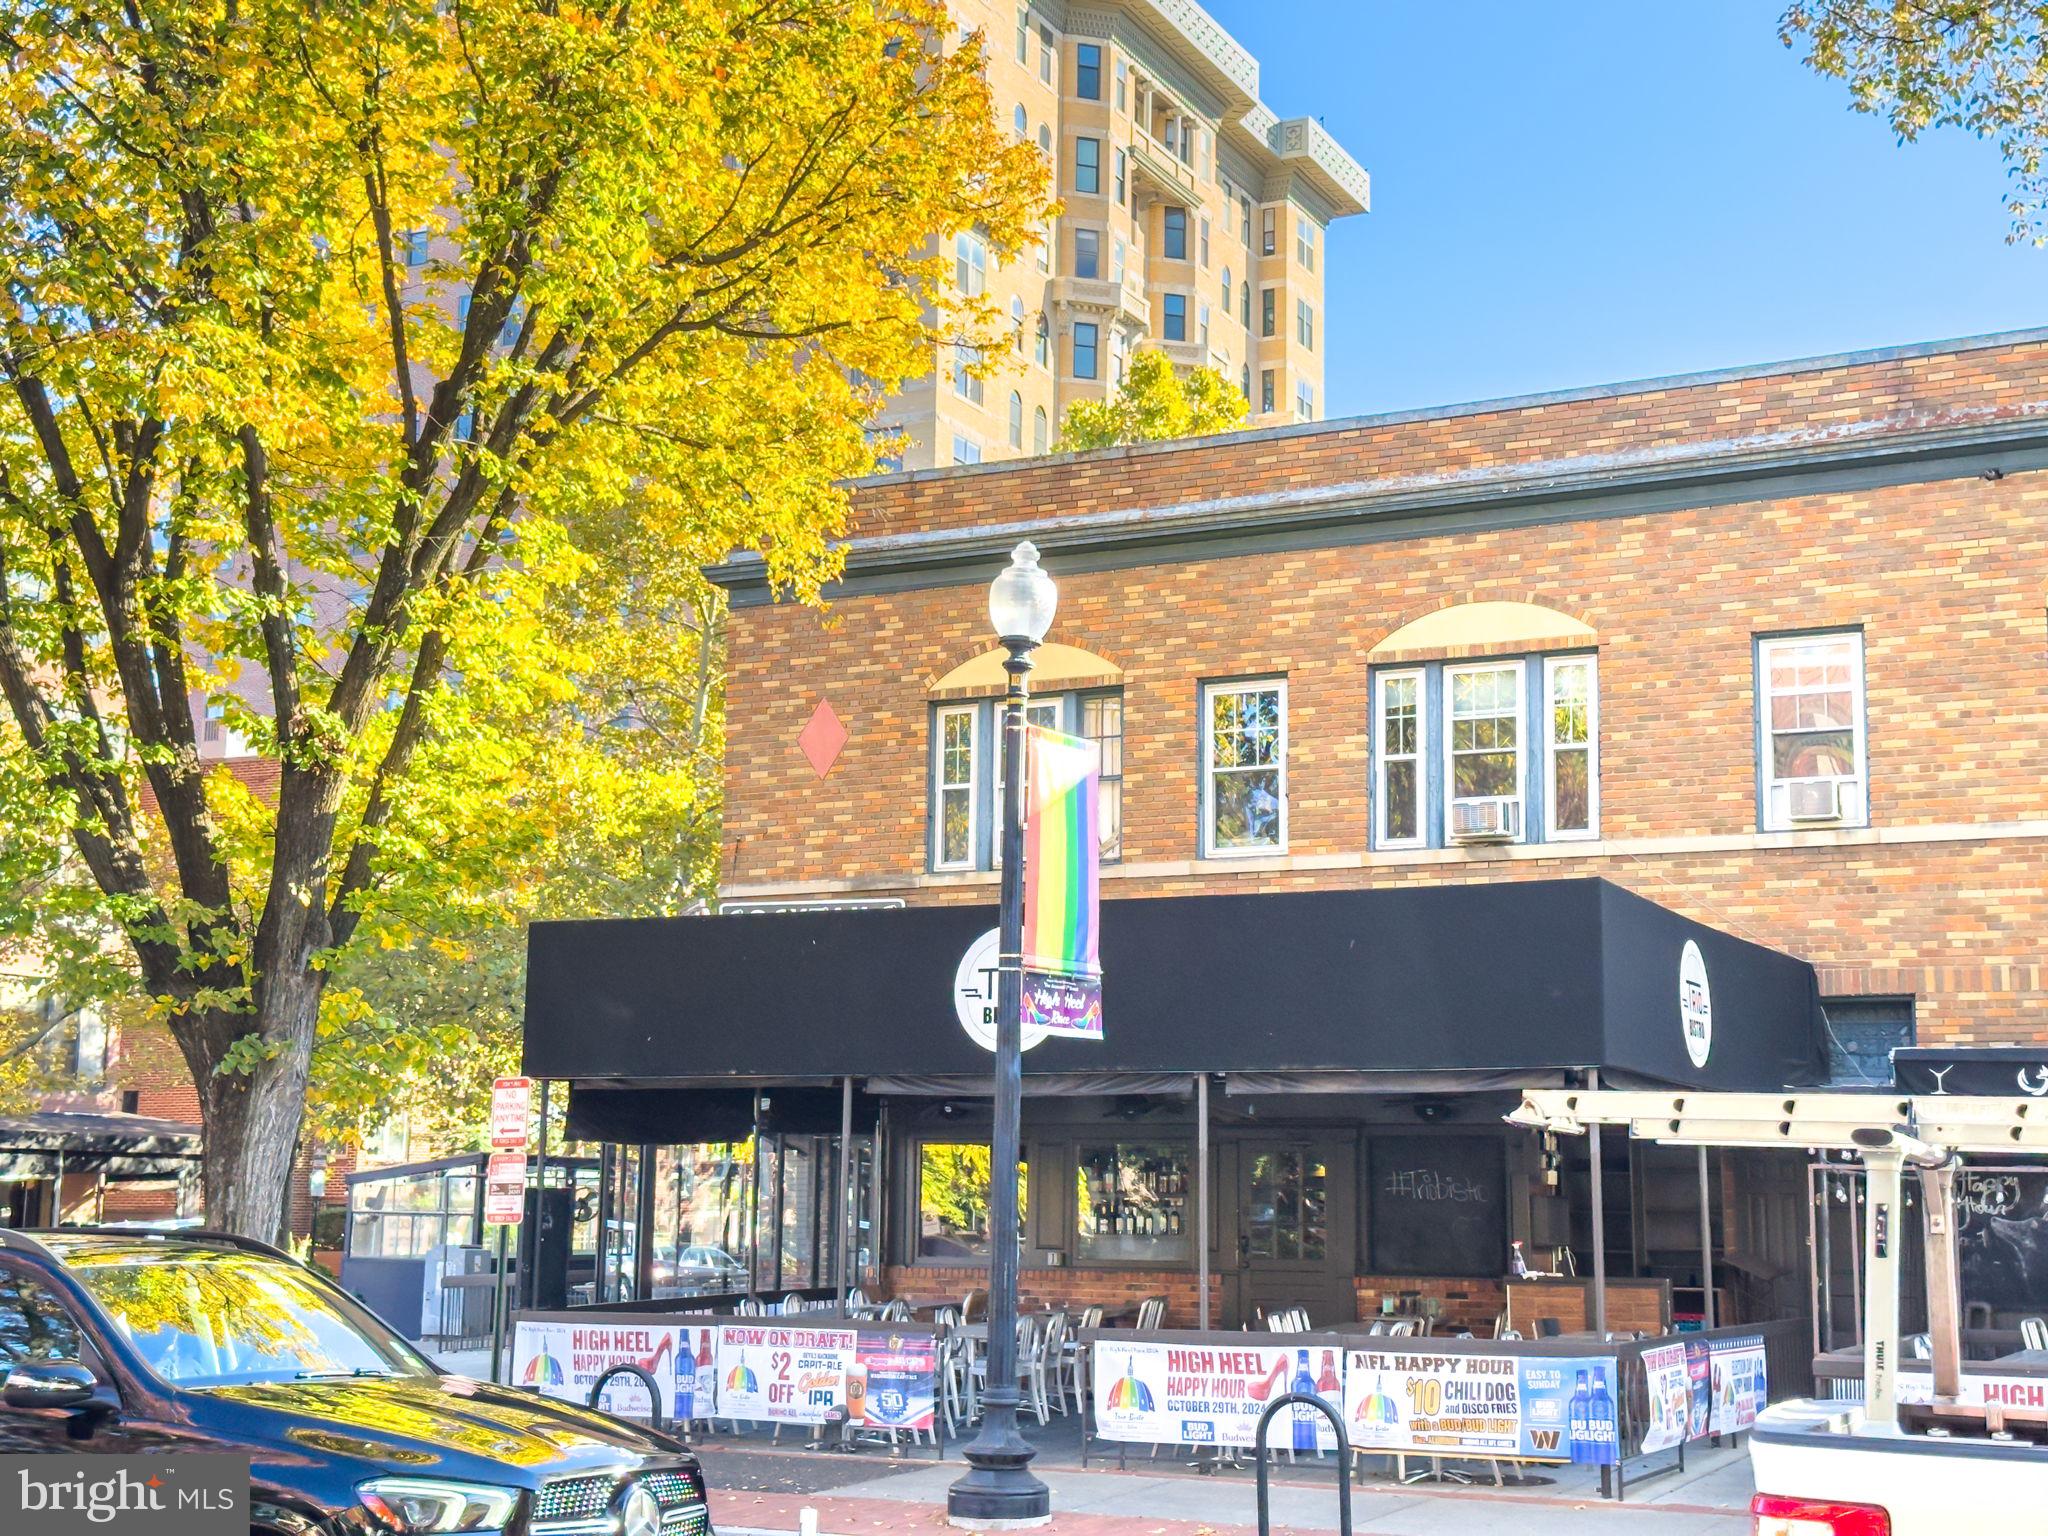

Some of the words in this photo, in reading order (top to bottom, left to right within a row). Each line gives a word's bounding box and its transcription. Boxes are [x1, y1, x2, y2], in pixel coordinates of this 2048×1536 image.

[1034, 989, 1060, 1010] High
[1065, 992, 1086, 1010] Heel
[505, 1090, 517, 1099] NO
[495, 1103, 526, 1111] PARKING
[572, 1330, 610, 1352] HIGH
[614, 1331, 654, 1353] HEEL
[724, 1328, 766, 1345] NOW
[768, 1330, 791, 1347] ON
[793, 1331, 855, 1350] DRAFT!
[573, 1354, 606, 1373] HAPPY
[1167, 1350, 1214, 1374] HIGH
[1219, 1352, 1267, 1376] HEEL
[1875, 1340, 1885, 1371] THULE
[771, 1351, 792, 1380] $2
[798, 1360, 843, 1371] CAPIT-ALE
[1355, 1355, 1390, 1370] NFL
[1394, 1356, 1461, 1373] HAPPY
[1466, 1360, 1514, 1375] HOUR
[676, 1375, 694, 1384] BUD
[1525, 1369, 1546, 1380] EASY
[1549, 1370, 1561, 1380] TO
[1167, 1376, 1208, 1397] HAPPY
[1211, 1378, 1245, 1399] HOUR
[1527, 1379, 1560, 1389] SUNDAY
[768, 1383, 795, 1404] OFF
[808, 1390, 834, 1407] IPA
[881, 1392, 904, 1410] 50
[1406, 1376, 1441, 1415] $10
[1445, 1381, 1481, 1400] CHILI
[1485, 1382, 1516, 1402] DOG
[1983, 1384, 2045, 1407] HIGH
[1167, 1399, 1210, 1413] OCTOBER
[1445, 1402, 1460, 1414] and
[1462, 1403, 1489, 1414] DISCO
[1491, 1403, 1517, 1414] FRIES
[1187, 1422, 1208, 1431] BUD
[1409, 1419, 1431, 1431] with
[1488, 1419, 1518, 1434] LIGHT
[1588, 1420, 1613, 1430] BUD
[1183, 1430, 1213, 1441] LIGHT
